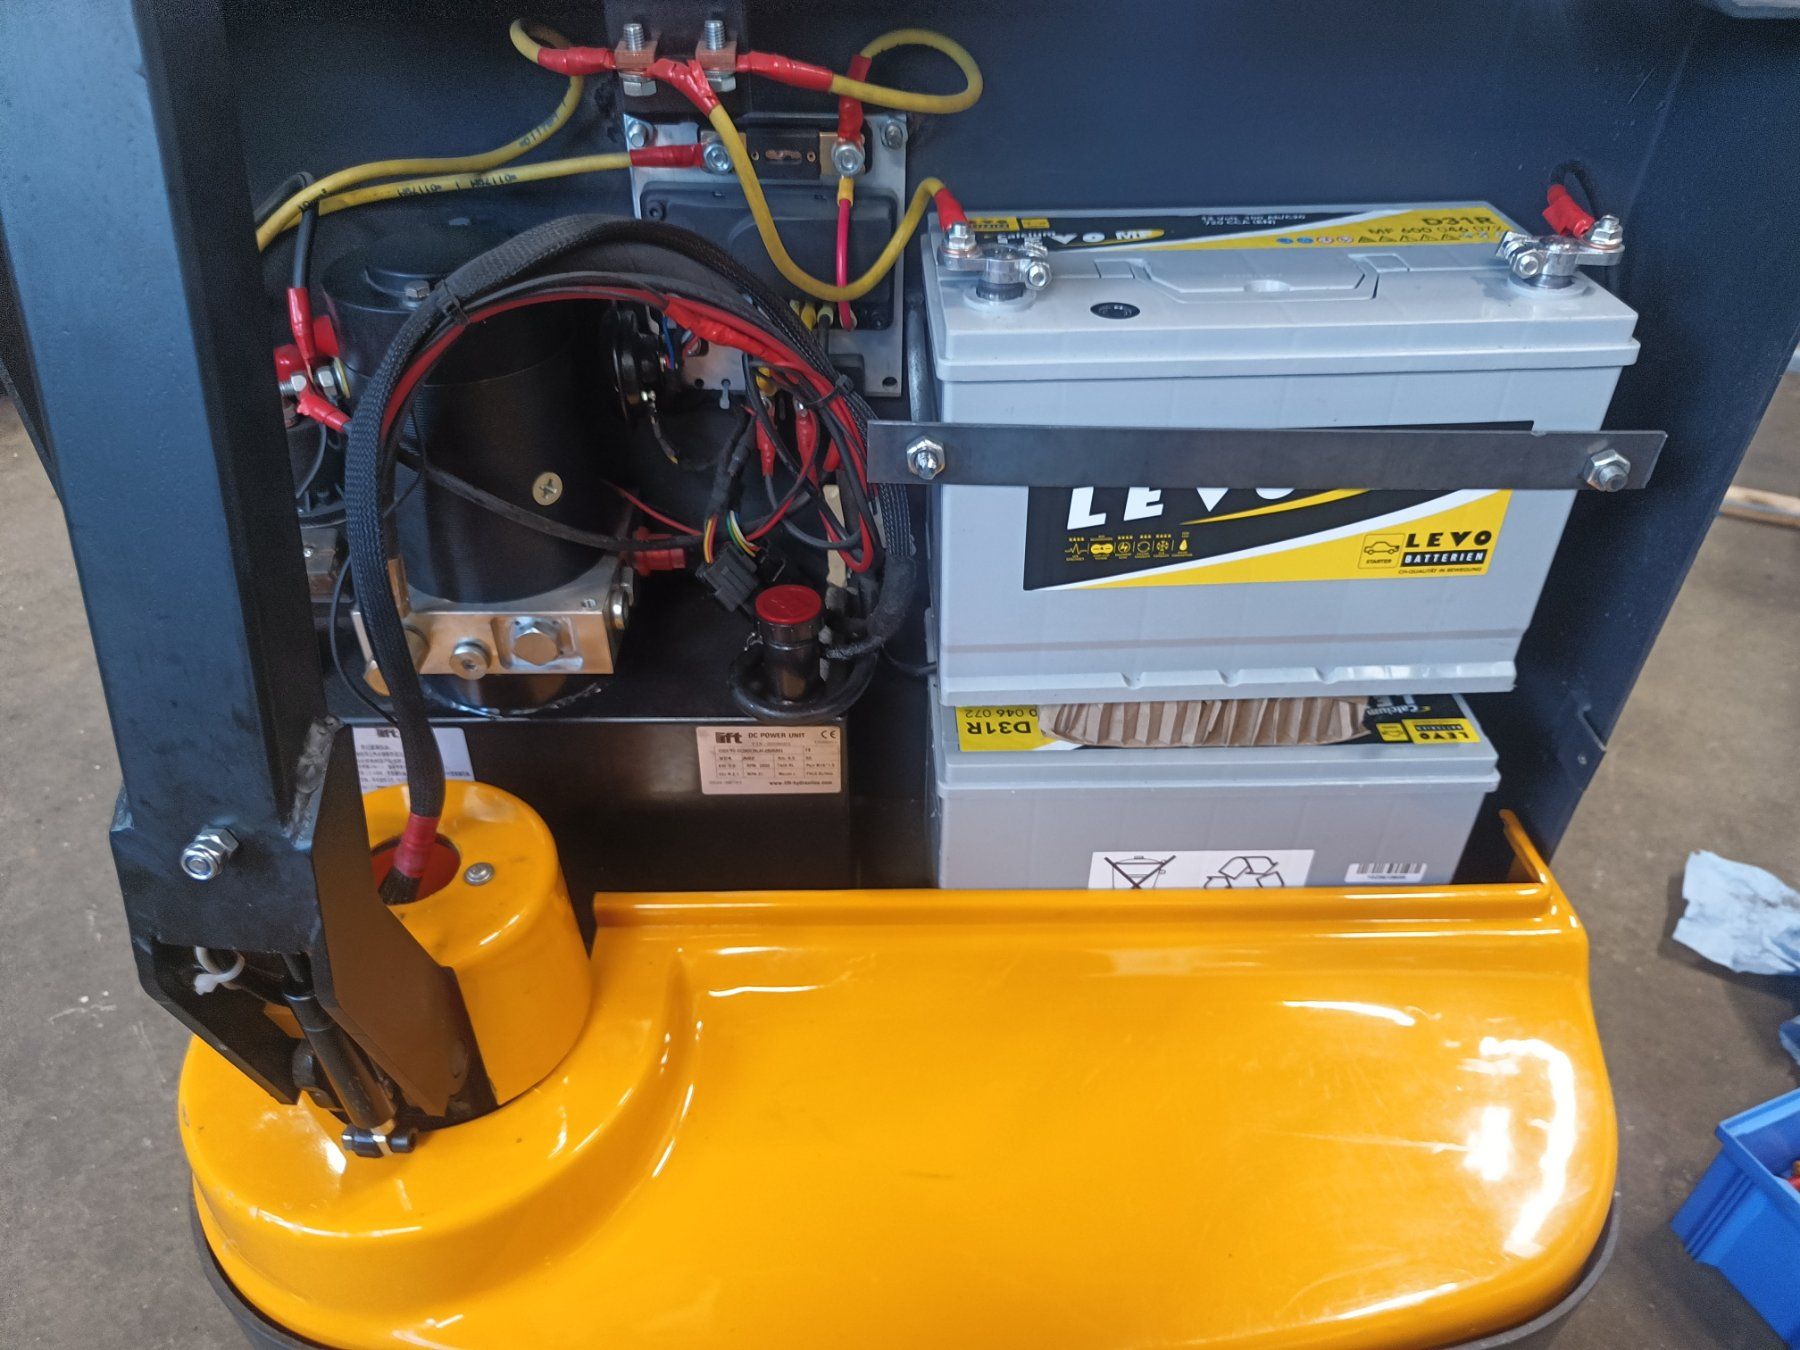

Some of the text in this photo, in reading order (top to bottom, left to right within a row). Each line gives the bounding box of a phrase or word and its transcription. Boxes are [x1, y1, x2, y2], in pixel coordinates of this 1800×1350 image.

[1421, 216, 1495, 226] D31R
[1405, 530, 1492, 548] LEVO
[1404, 552, 1484, 564] BATTERIEN
[965, 708, 992, 719] 072
[995, 708, 1024, 718] 046
[966, 721, 1032, 736] D31R
[1419, 731, 1469, 740] LEVO
